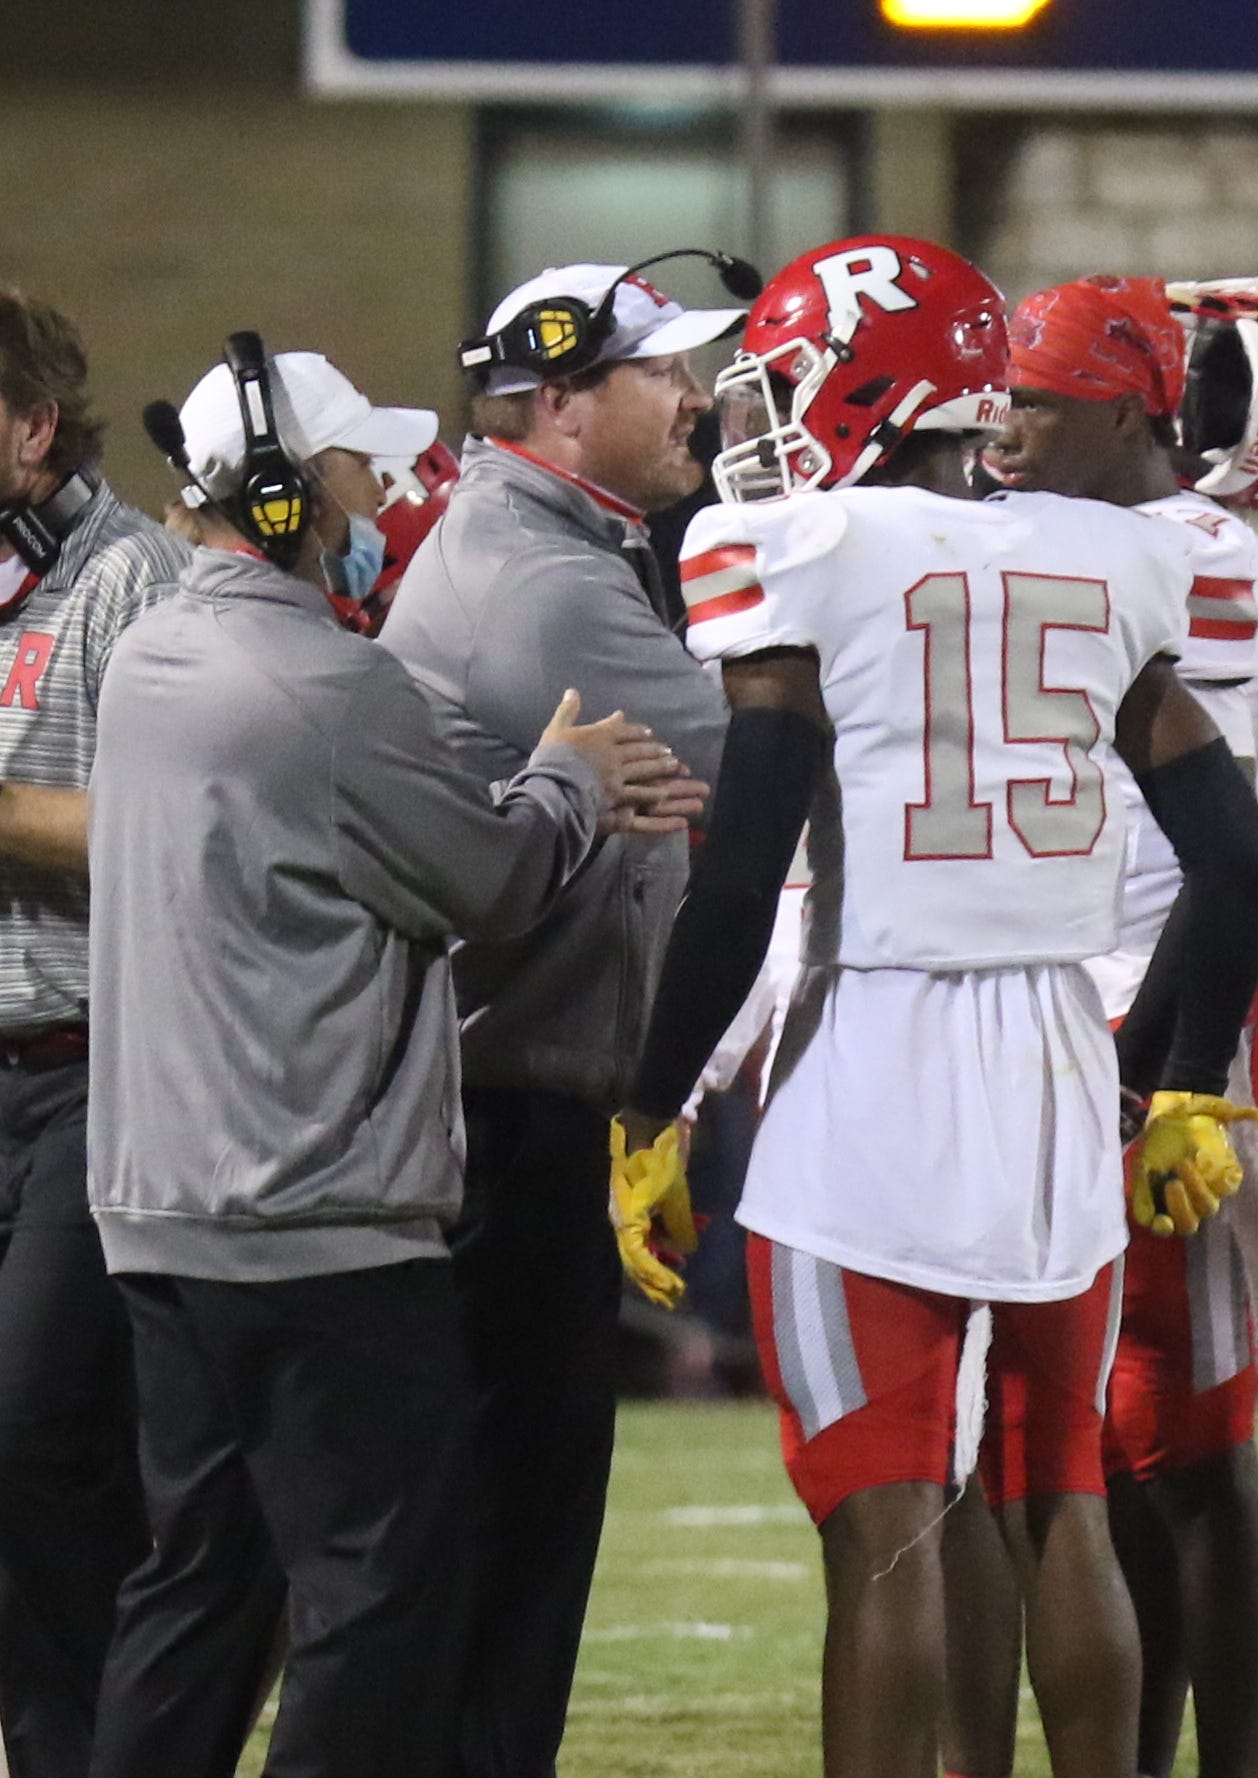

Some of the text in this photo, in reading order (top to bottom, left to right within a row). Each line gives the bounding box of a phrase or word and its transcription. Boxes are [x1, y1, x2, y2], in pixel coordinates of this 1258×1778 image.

[812, 246, 919, 331] R
[0, 631, 56, 711] R
[904, 570, 1111, 861] 15
